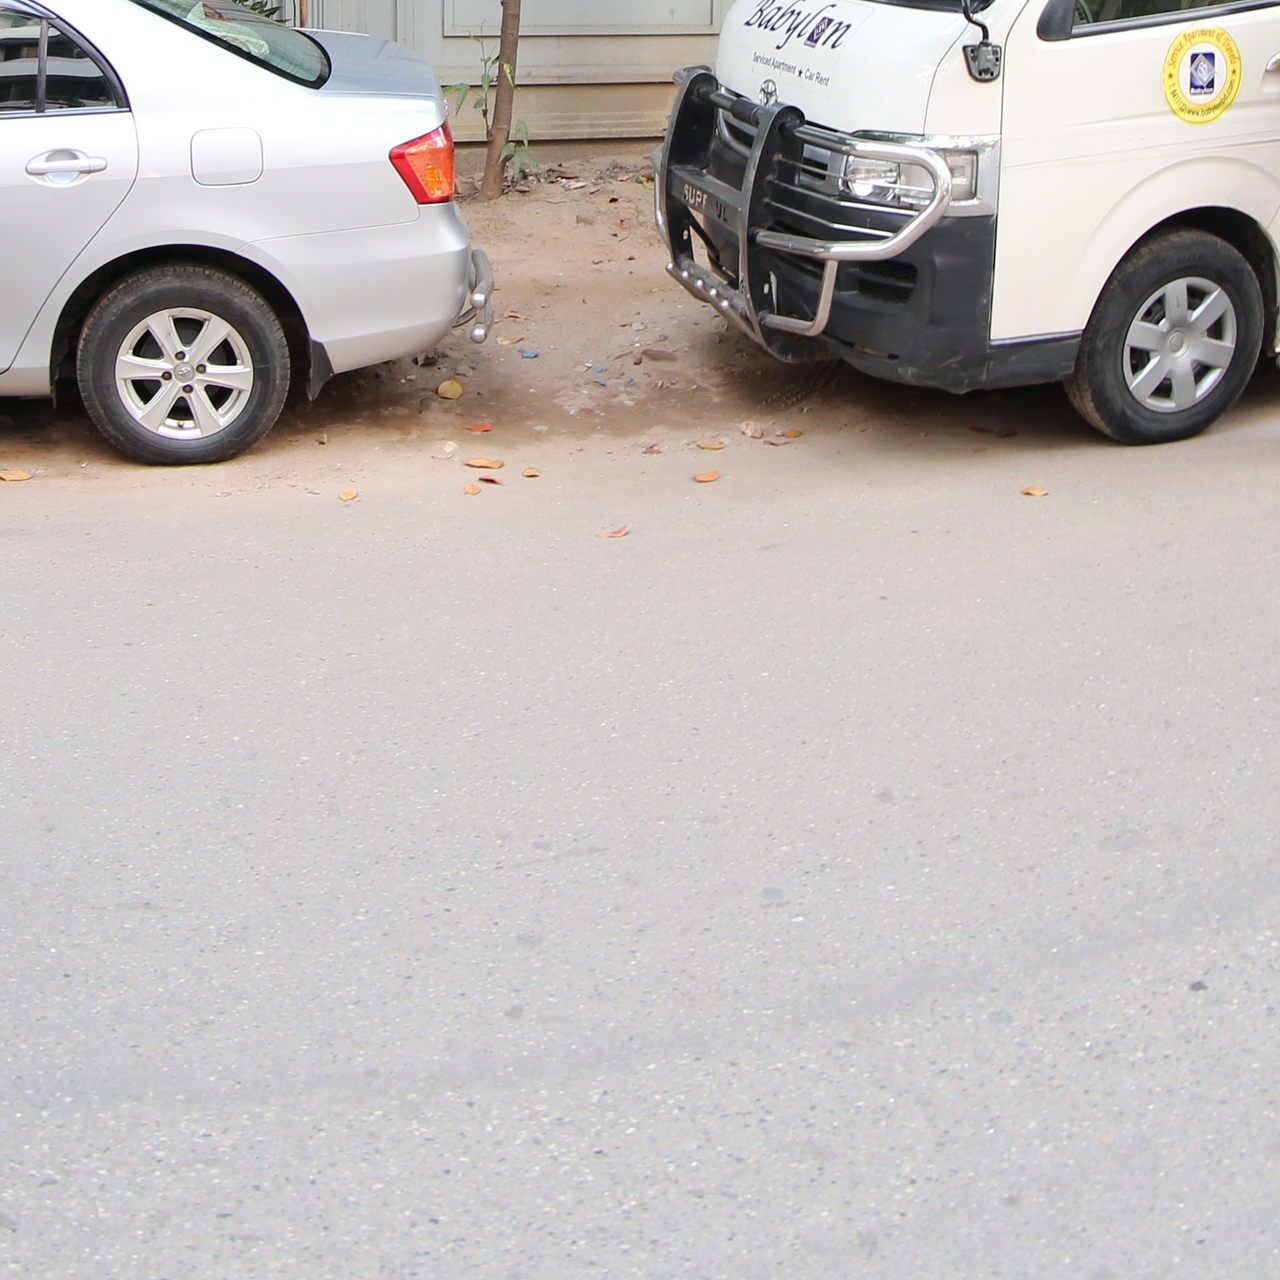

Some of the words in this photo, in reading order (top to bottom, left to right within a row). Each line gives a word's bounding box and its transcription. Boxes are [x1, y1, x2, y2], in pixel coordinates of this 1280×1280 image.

[751, 51, 772, 67] Serviced
[771, 57, 797, 75] Apartment
[804, 68, 816, 81] Car
[814, 71, 830, 87] Rent
